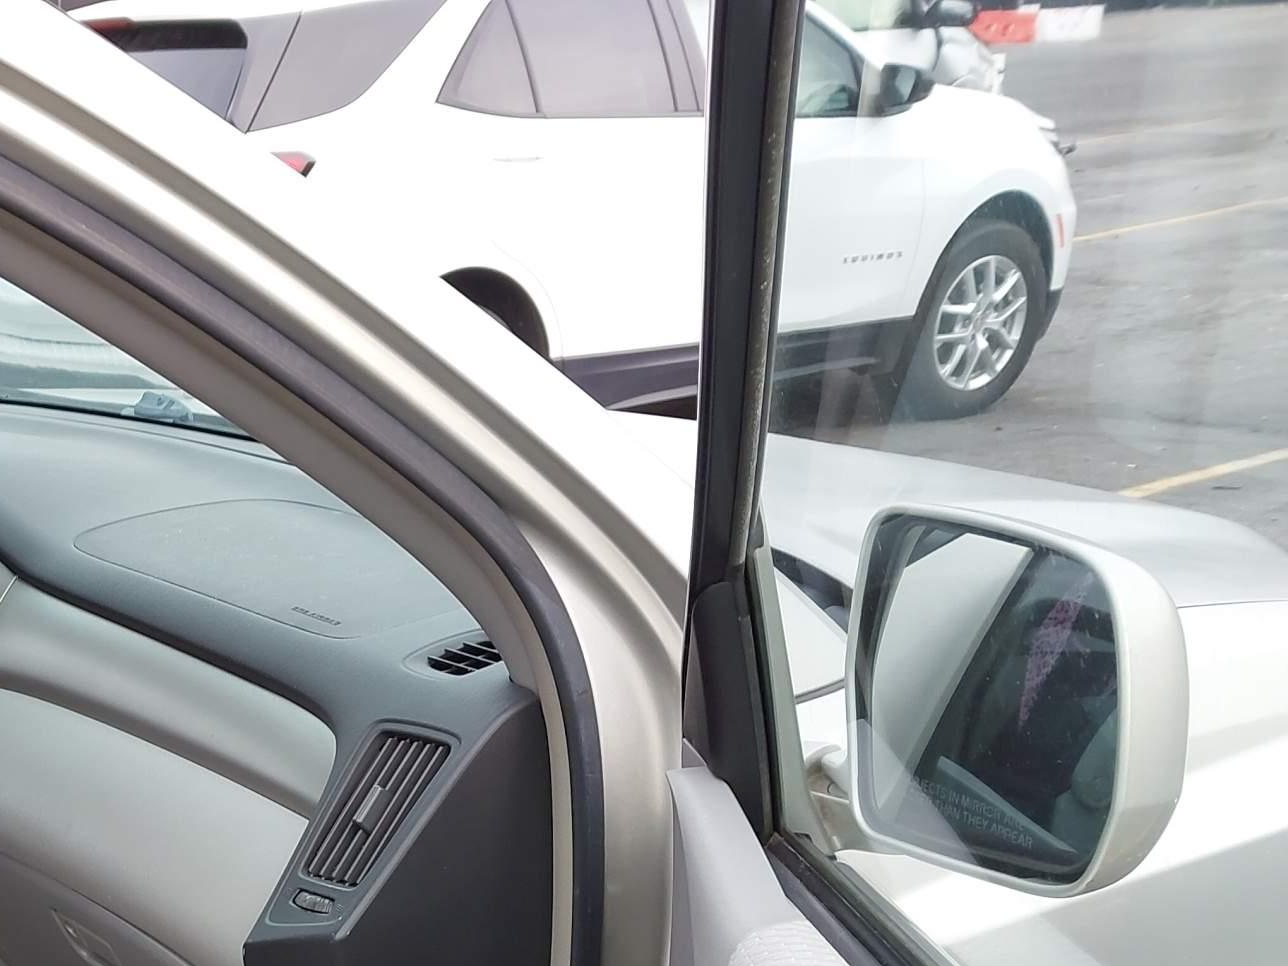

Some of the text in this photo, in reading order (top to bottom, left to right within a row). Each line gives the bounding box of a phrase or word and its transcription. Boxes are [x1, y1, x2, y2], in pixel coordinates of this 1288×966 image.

[948, 790, 959, 805] IN
[960, 793, 1001, 820] MIRROR
[962, 811, 989, 830] THEY
[991, 823, 1033, 849] APPEAR
